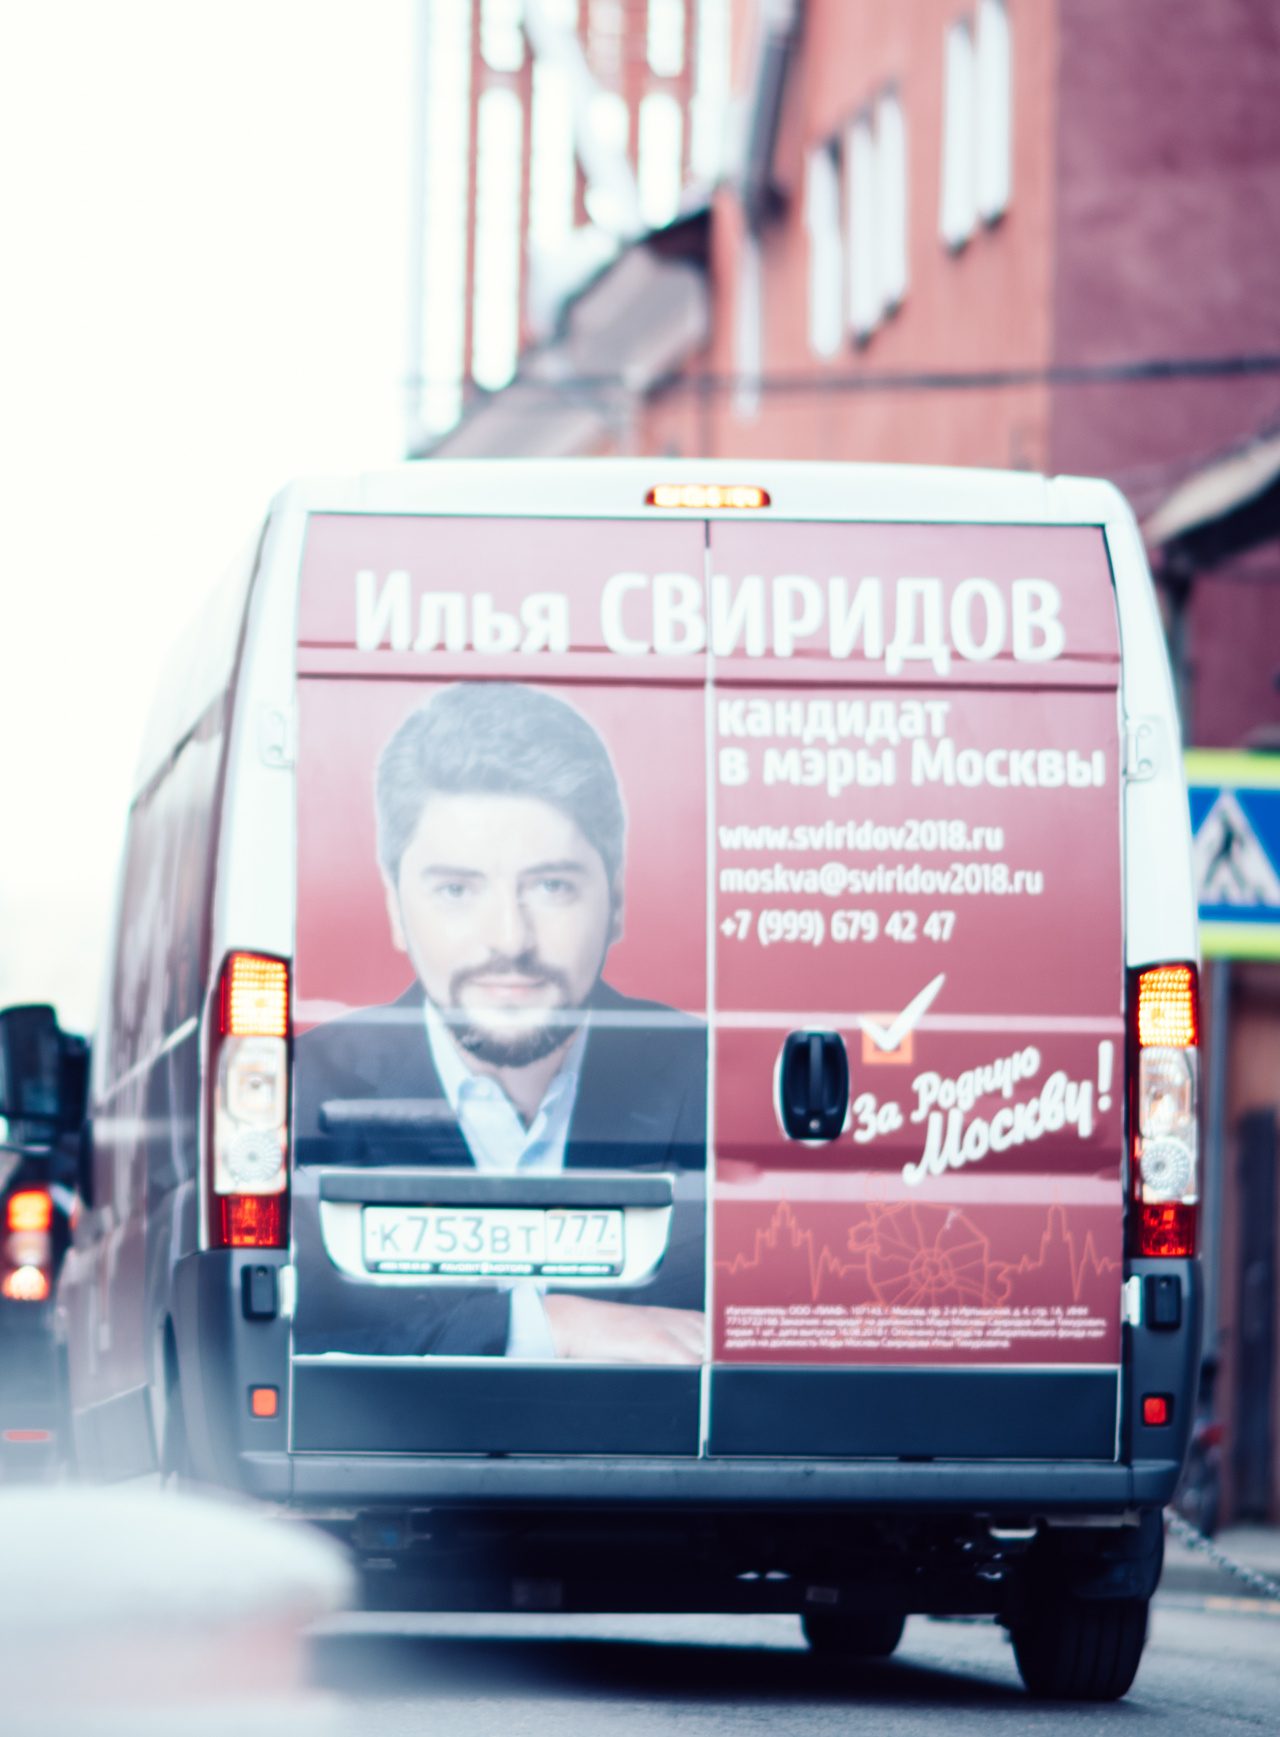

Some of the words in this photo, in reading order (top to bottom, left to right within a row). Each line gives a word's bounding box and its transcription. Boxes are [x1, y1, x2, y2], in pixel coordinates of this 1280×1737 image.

[354, 569, 569, 652] Илья
[600, 572, 1065, 676] СВИРИДОВ
[719, 699, 951, 746] кандидат
[719, 747, 750, 786] в
[763, 747, 897, 798] мэры
[910, 737, 1106, 788] Москвы
[719, 820, 1005, 851] www.sviridov2018.ru
[720, 862, 1044, 897] moskva@sviridov2018.ru
[720, 909, 752, 942] +7
[757, 909, 825, 947] (999)
[830, 911, 879, 943] 679
[884, 911, 918, 943] 42
[923, 911, 956, 943] 47
[853, 1093, 903, 1144] За
[910, 1045, 1041, 1124] Родную
[902, 1039, 1114, 1187] Москву!
[548, 1214, 610, 1245] 777
